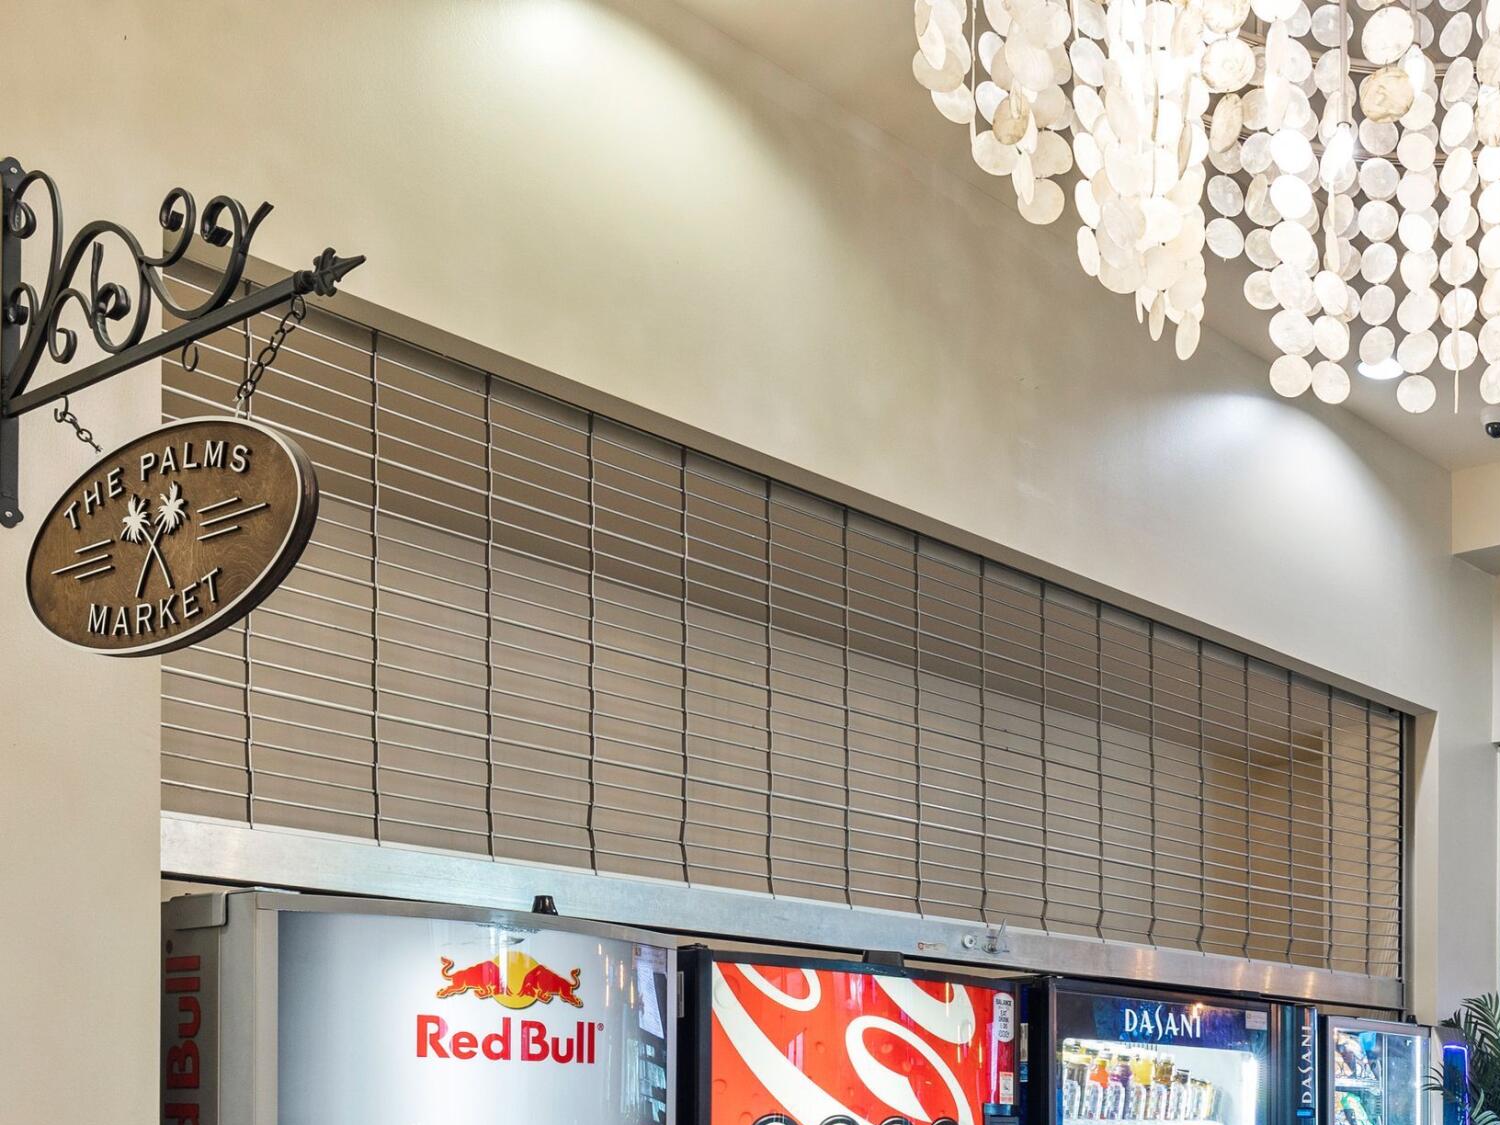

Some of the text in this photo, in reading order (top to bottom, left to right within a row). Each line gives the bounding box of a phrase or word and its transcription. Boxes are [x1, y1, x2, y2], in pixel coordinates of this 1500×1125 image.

[64, 440, 251, 529] THE PALMS
[87, 566, 223, 636] MARKET
[416, 1014, 511, 1061] Red
[1125, 1004, 1201, 1041] DASANI
[1298, 1025, 1313, 1104] DASANI
